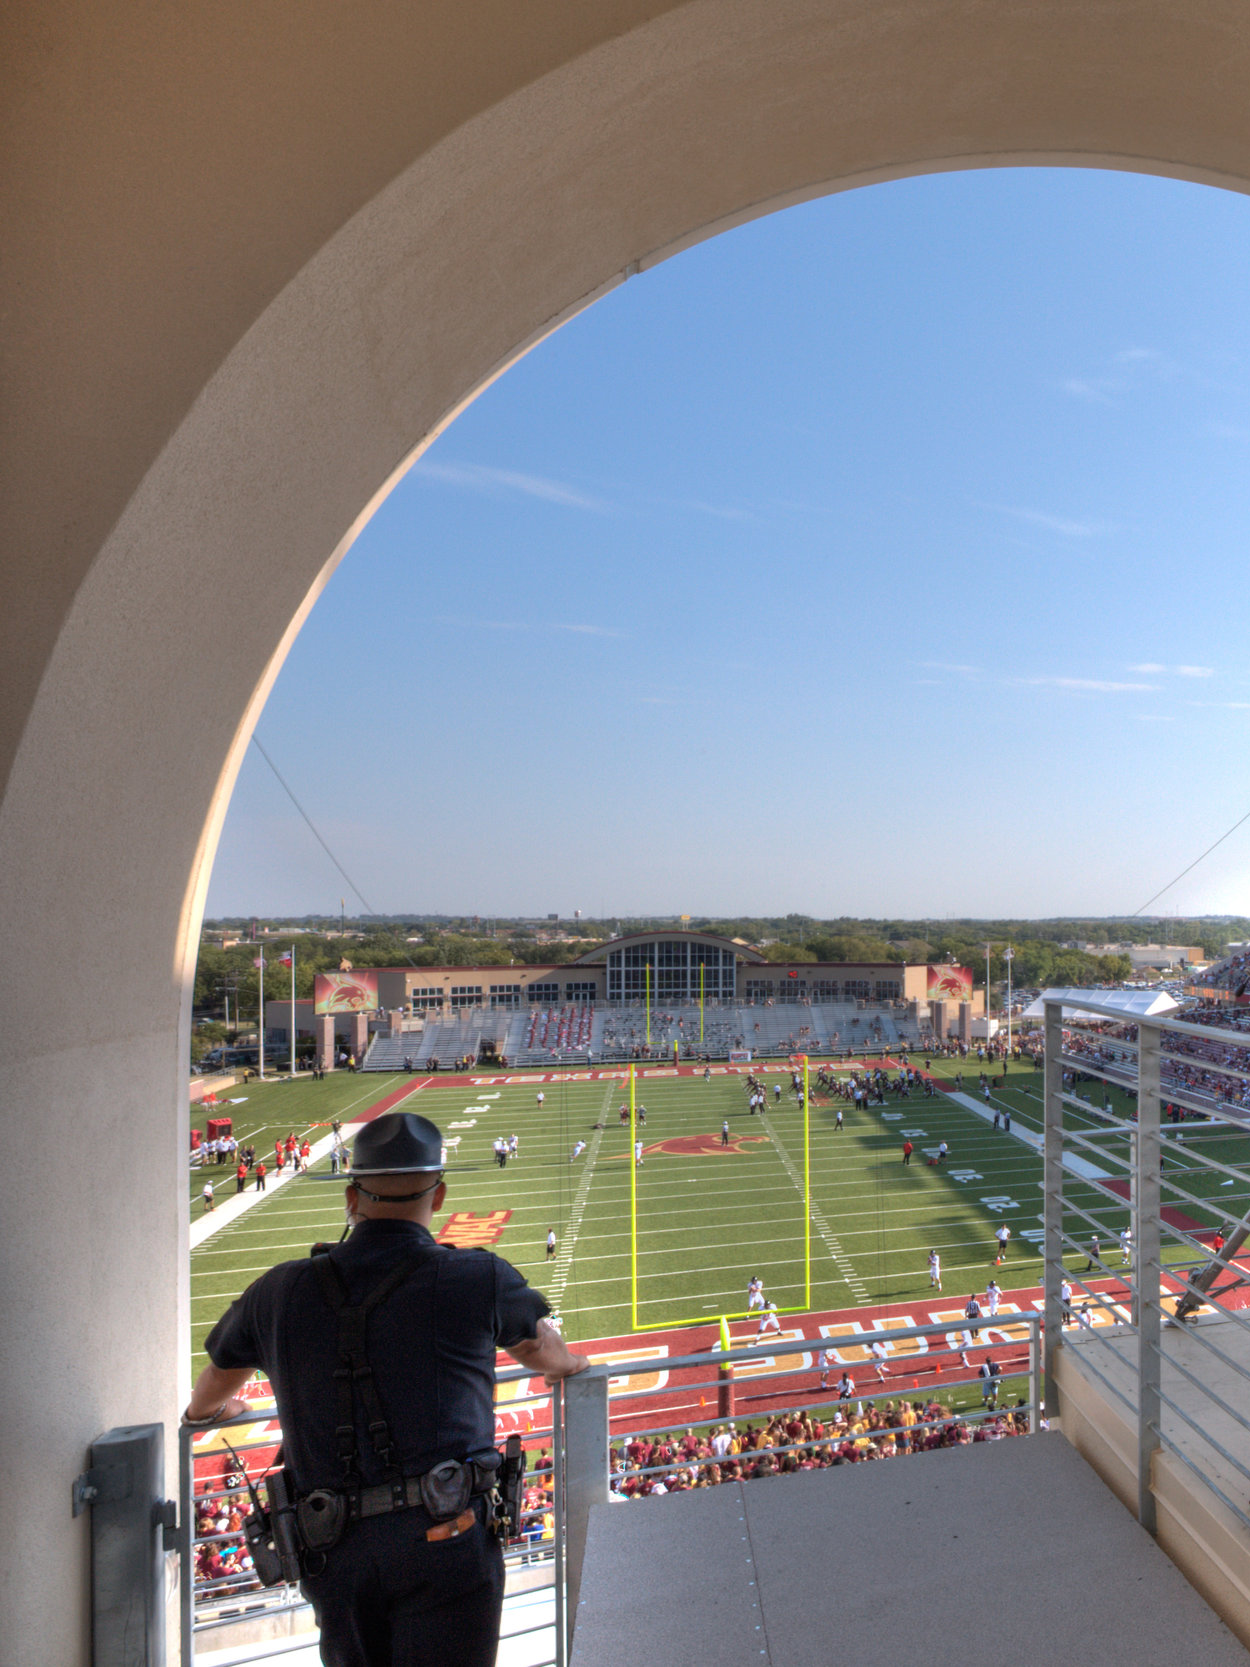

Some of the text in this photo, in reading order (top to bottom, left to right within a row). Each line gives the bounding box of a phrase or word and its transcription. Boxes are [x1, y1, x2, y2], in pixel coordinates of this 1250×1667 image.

[470, 1062, 865, 1085] TEXAS STATE
[980, 1196, 1021, 1213] 20
[434, 1209, 514, 1249] WAC
